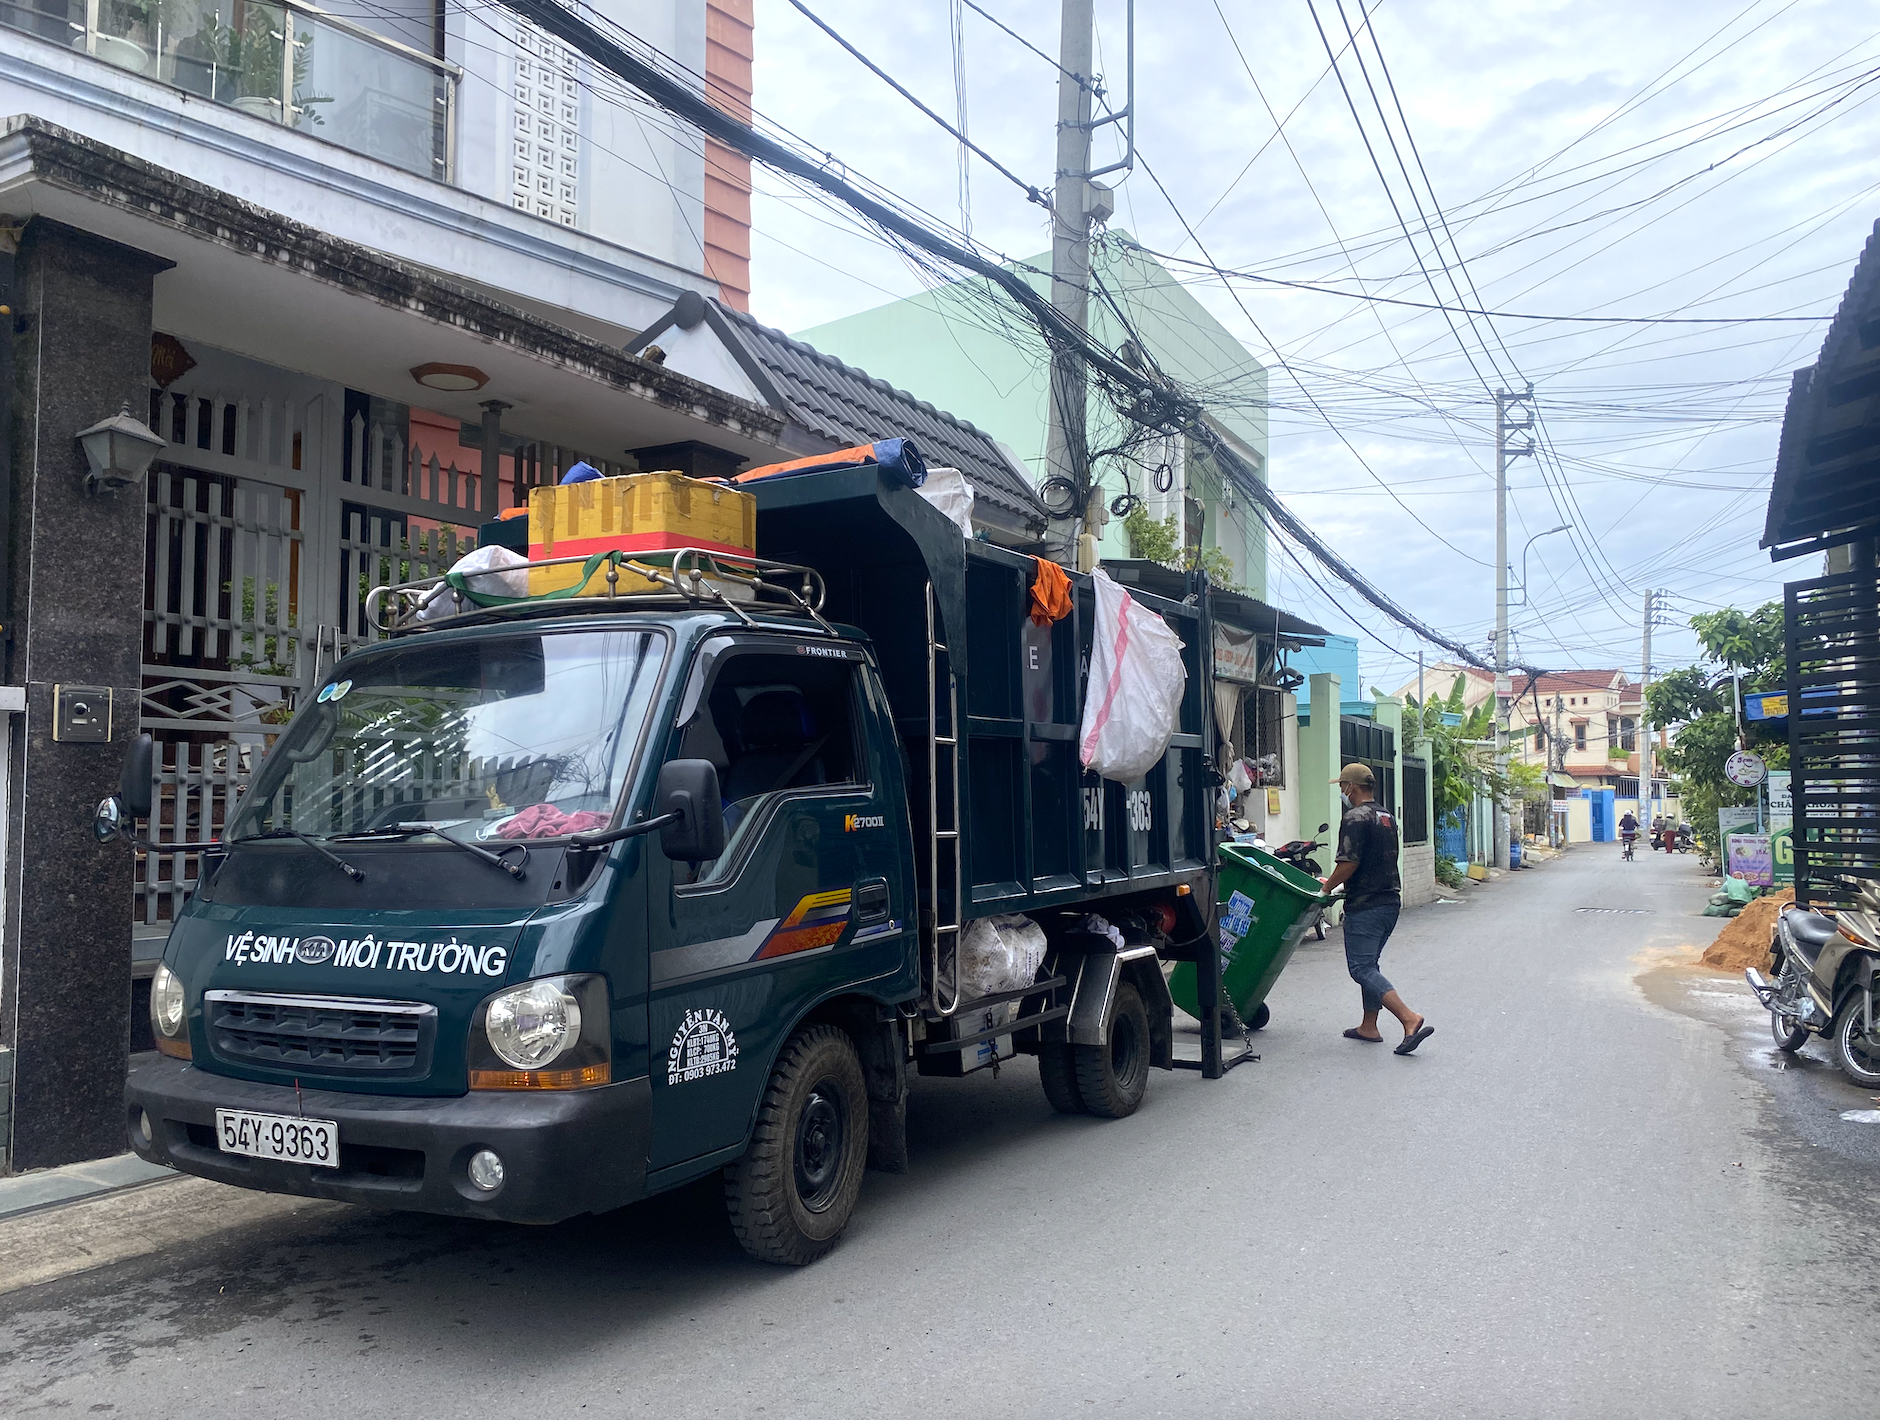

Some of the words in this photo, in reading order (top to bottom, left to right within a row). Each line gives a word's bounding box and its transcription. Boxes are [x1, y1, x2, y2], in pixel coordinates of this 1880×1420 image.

[806, 646, 847, 658] FRONTIER
[1027, 646, 1039, 670] E
[225, 930, 255, 968] VỆ
[254, 936, 299, 965] SINH
[300, 939, 329, 961] KIA
[333, 932, 382, 969] MÔI
[385, 935, 507, 977] TRƯỜNG
[668, 1008, 703, 1074] NGUYỄN
[668, 1072, 682, 1086] ĐT:
[683, 1067, 705, 1082] 0903
[705, 1059, 736, 1076] 973.472
